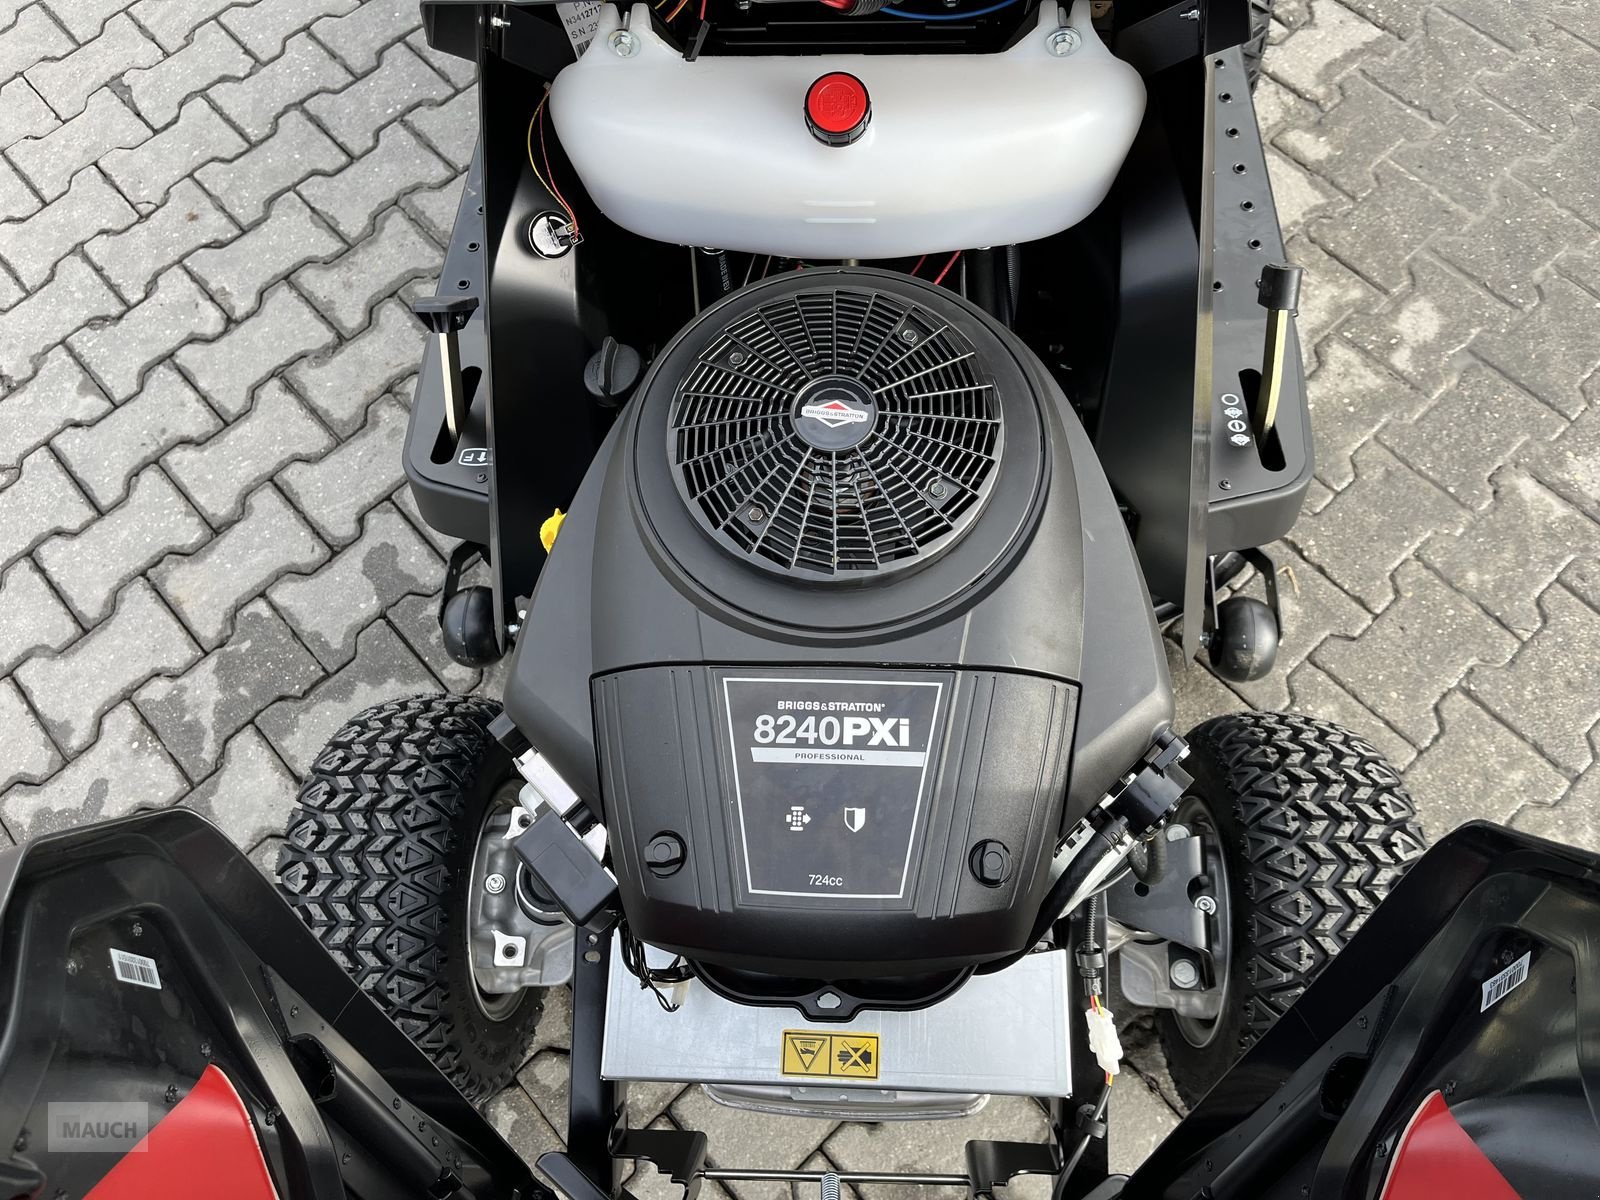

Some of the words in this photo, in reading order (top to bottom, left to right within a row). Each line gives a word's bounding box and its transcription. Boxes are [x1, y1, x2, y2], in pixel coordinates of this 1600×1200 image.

[753, 714, 910, 747] 8240PXi
[794, 752, 865, 761] PROFESSIONAL
[808, 874, 843, 886] 724cc
